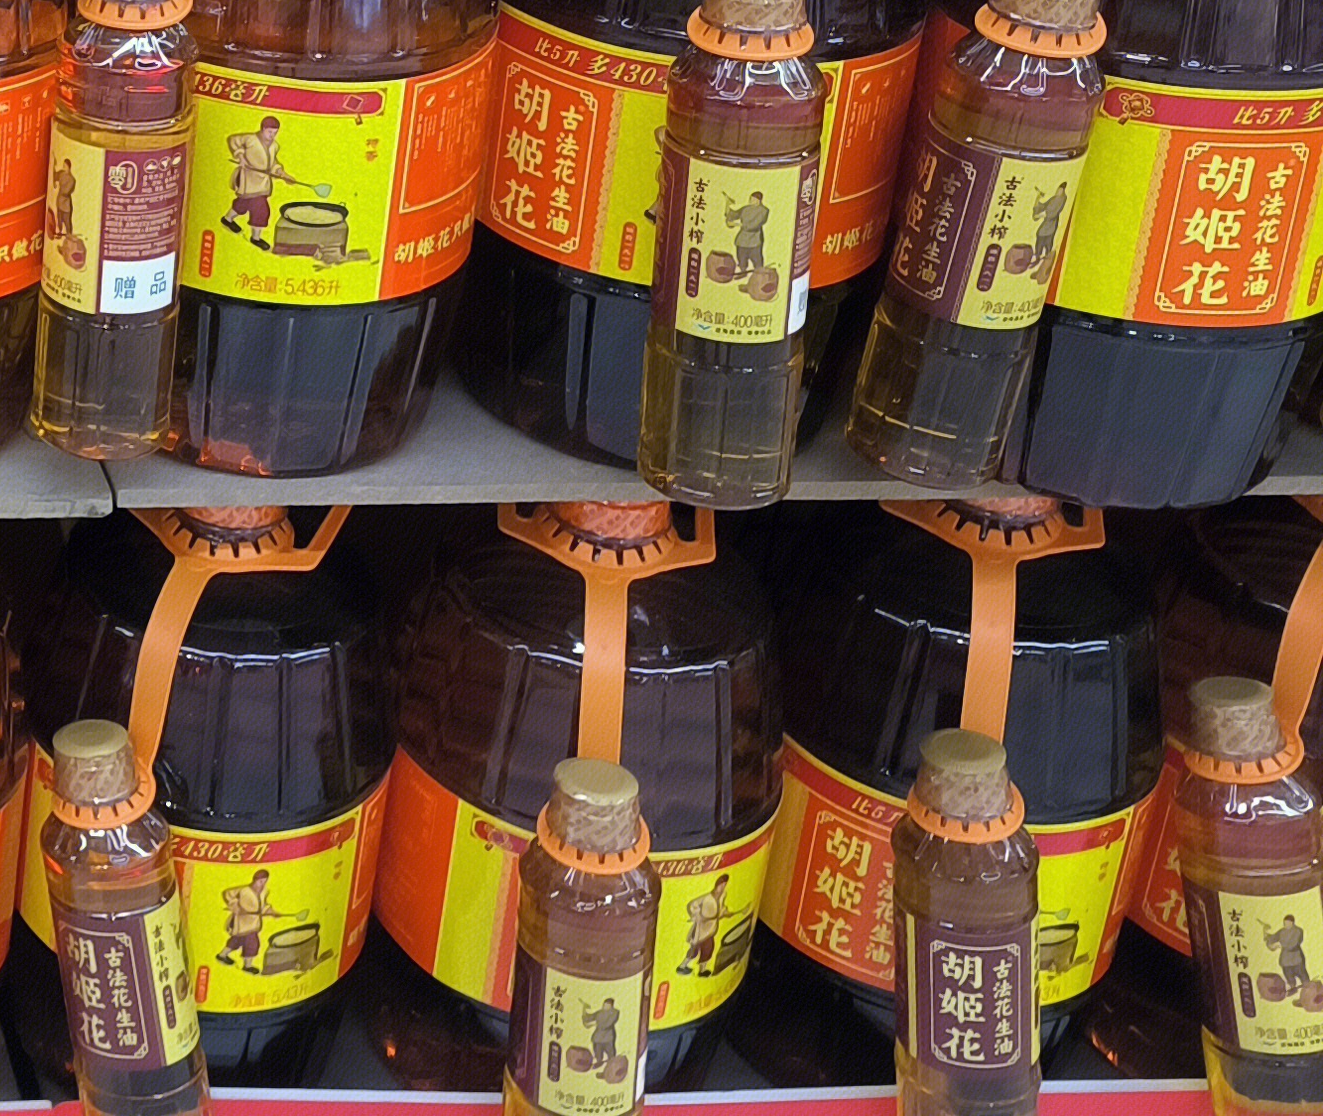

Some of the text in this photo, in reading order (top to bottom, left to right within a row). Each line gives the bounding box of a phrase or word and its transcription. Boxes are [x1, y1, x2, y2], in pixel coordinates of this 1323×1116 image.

[500, 77, 552, 232] 胡姬花
[545, 104, 584, 237] 古法花生油
[987, 176, 1025, 241] 古法小榨
[689, 178, 710, 245] 古法小榨
[1172, 155, 1256, 307] 胡姬花
[1242, 162, 1295, 299] 古法花生油
[113, 269, 167, 300] 赠品
[813, 827, 872, 959] 胡姬花
[103, 945, 138, 1047] 古法花生油
[938, 950, 986, 1062] 胡姬花
[992, 958, 1014, 1057] 古法花生油
